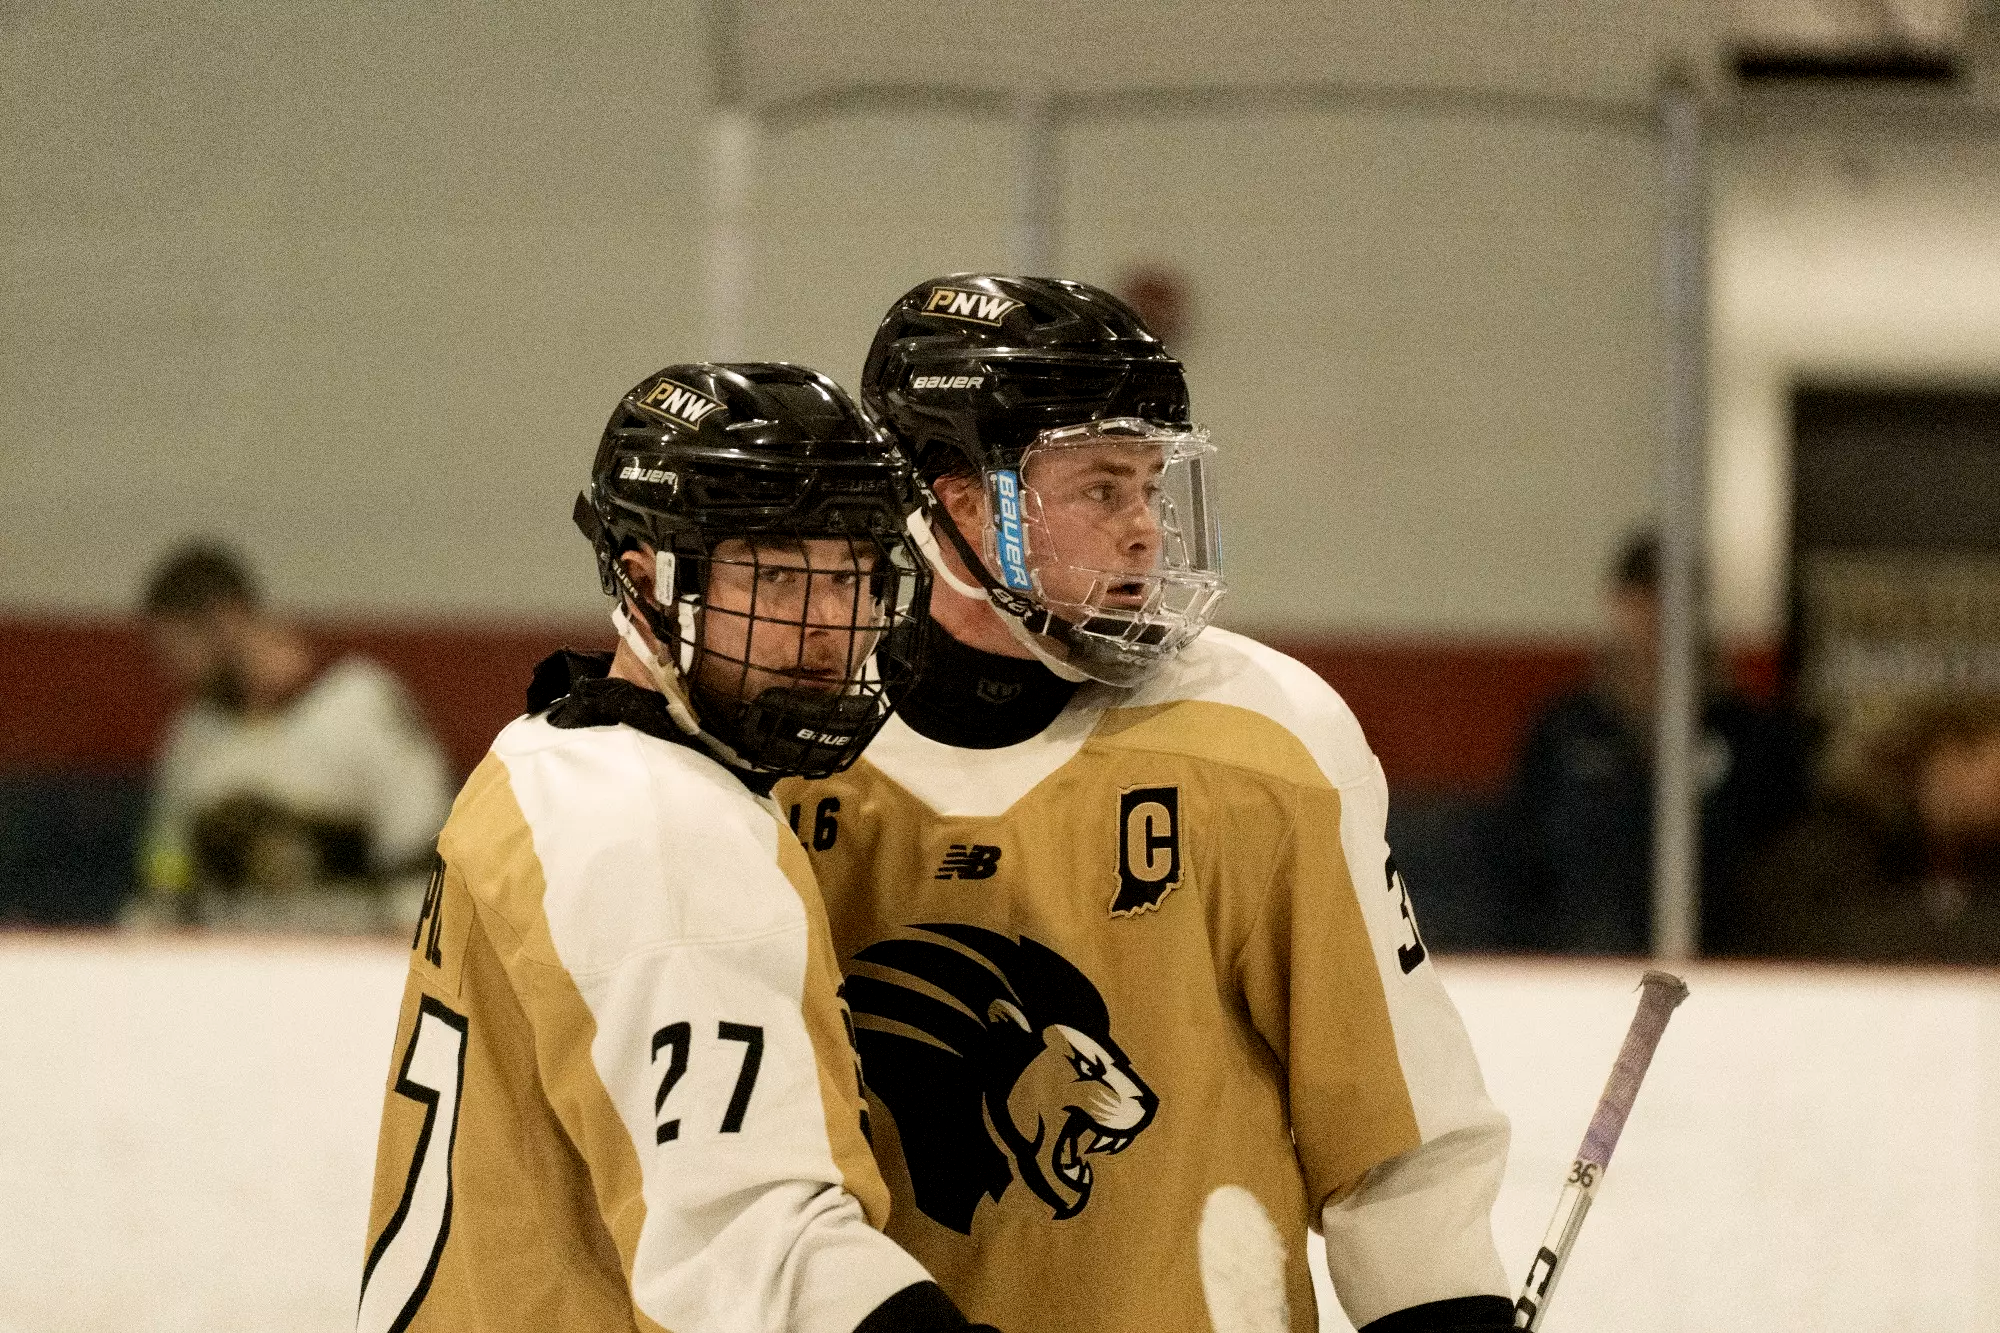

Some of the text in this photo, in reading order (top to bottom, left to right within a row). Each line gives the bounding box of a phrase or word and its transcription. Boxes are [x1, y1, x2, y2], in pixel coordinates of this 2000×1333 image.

[927, 291, 1013, 320] PNW
[913, 376, 984, 389] BAUER
[646, 383, 716, 422] PNW
[999, 474, 1029, 587] BAUER
[797, 728, 851, 746] BUE
[1127, 802, 1172, 882] C
[651, 1020, 765, 1146] 27
[1567, 1160, 1599, 1189] 36
